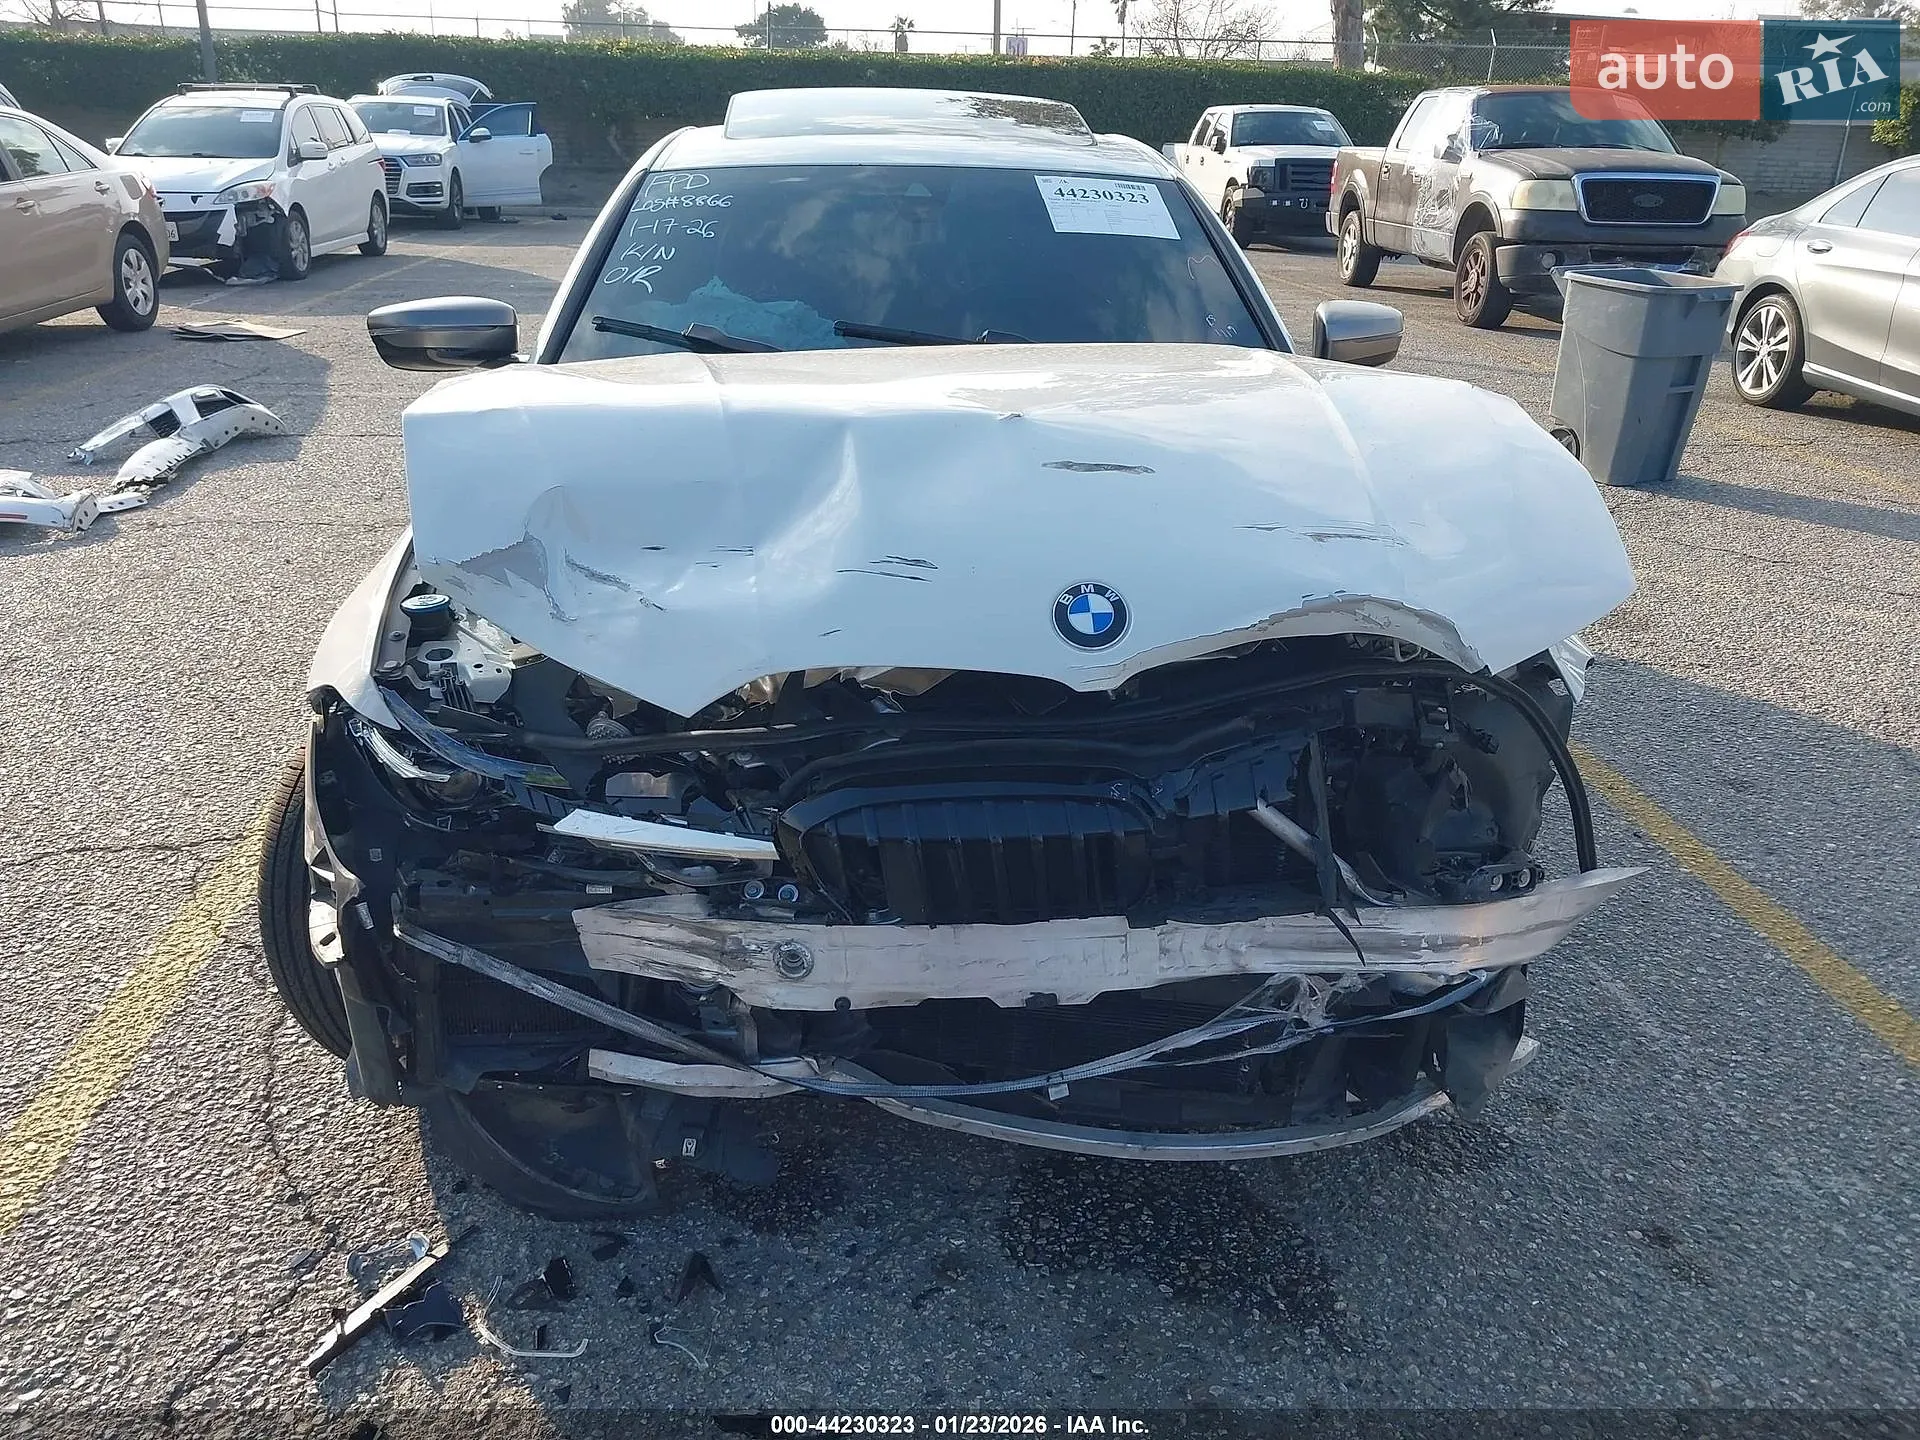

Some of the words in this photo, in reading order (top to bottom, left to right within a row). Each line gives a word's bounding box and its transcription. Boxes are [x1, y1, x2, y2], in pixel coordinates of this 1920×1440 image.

[645, 173, 710, 197] FPD
[1053, 187, 1150, 204] 44230323
[629, 218, 719, 238] 1-17-26
[620, 242, 676, 261] K/N
[1059, 584, 1119, 605] BMW
